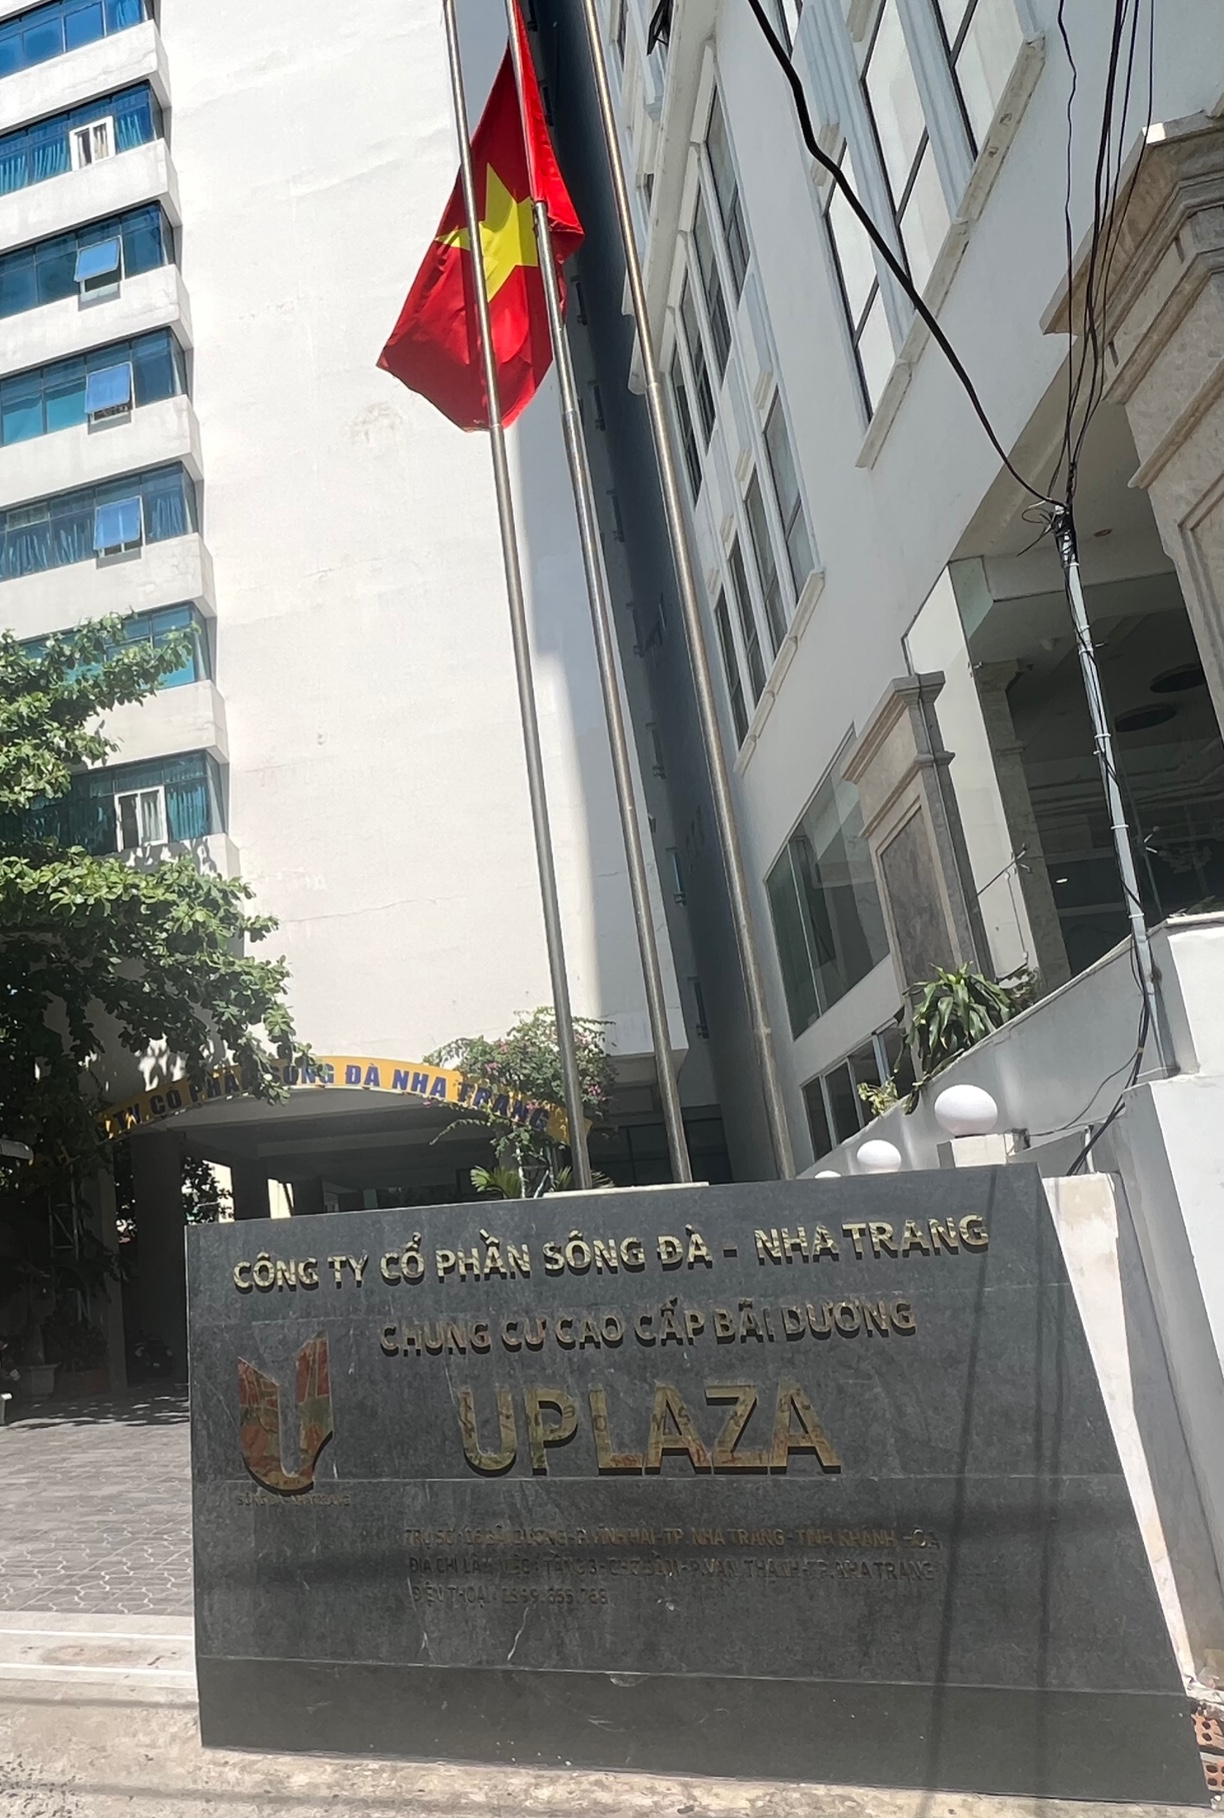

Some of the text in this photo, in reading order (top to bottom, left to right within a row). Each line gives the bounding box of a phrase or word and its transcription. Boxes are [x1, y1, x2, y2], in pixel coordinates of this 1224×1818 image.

[345, 1063, 380, 1087] ĐÀ
[392, 1069, 447, 1098] NHA
[458, 1080, 550, 1131] TRANG
[233, 1252, 320, 1291] CÔNG
[328, 1254, 369, 1287] TY
[380, 1232, 426, 1284] CỔ
[435, 1229, 532, 1281] PHẦN
[542, 1230, 645, 1272] SÔNG
[657, 1224, 714, 1268] ĐÀ
[755, 1225, 841, 1264] NHA
[843, 1214, 990, 1258] TRANG
[380, 1322, 492, 1354] CHUNG
[556, 1315, 623, 1348] CAO
[458, 1377, 842, 1475] UPLAZA
